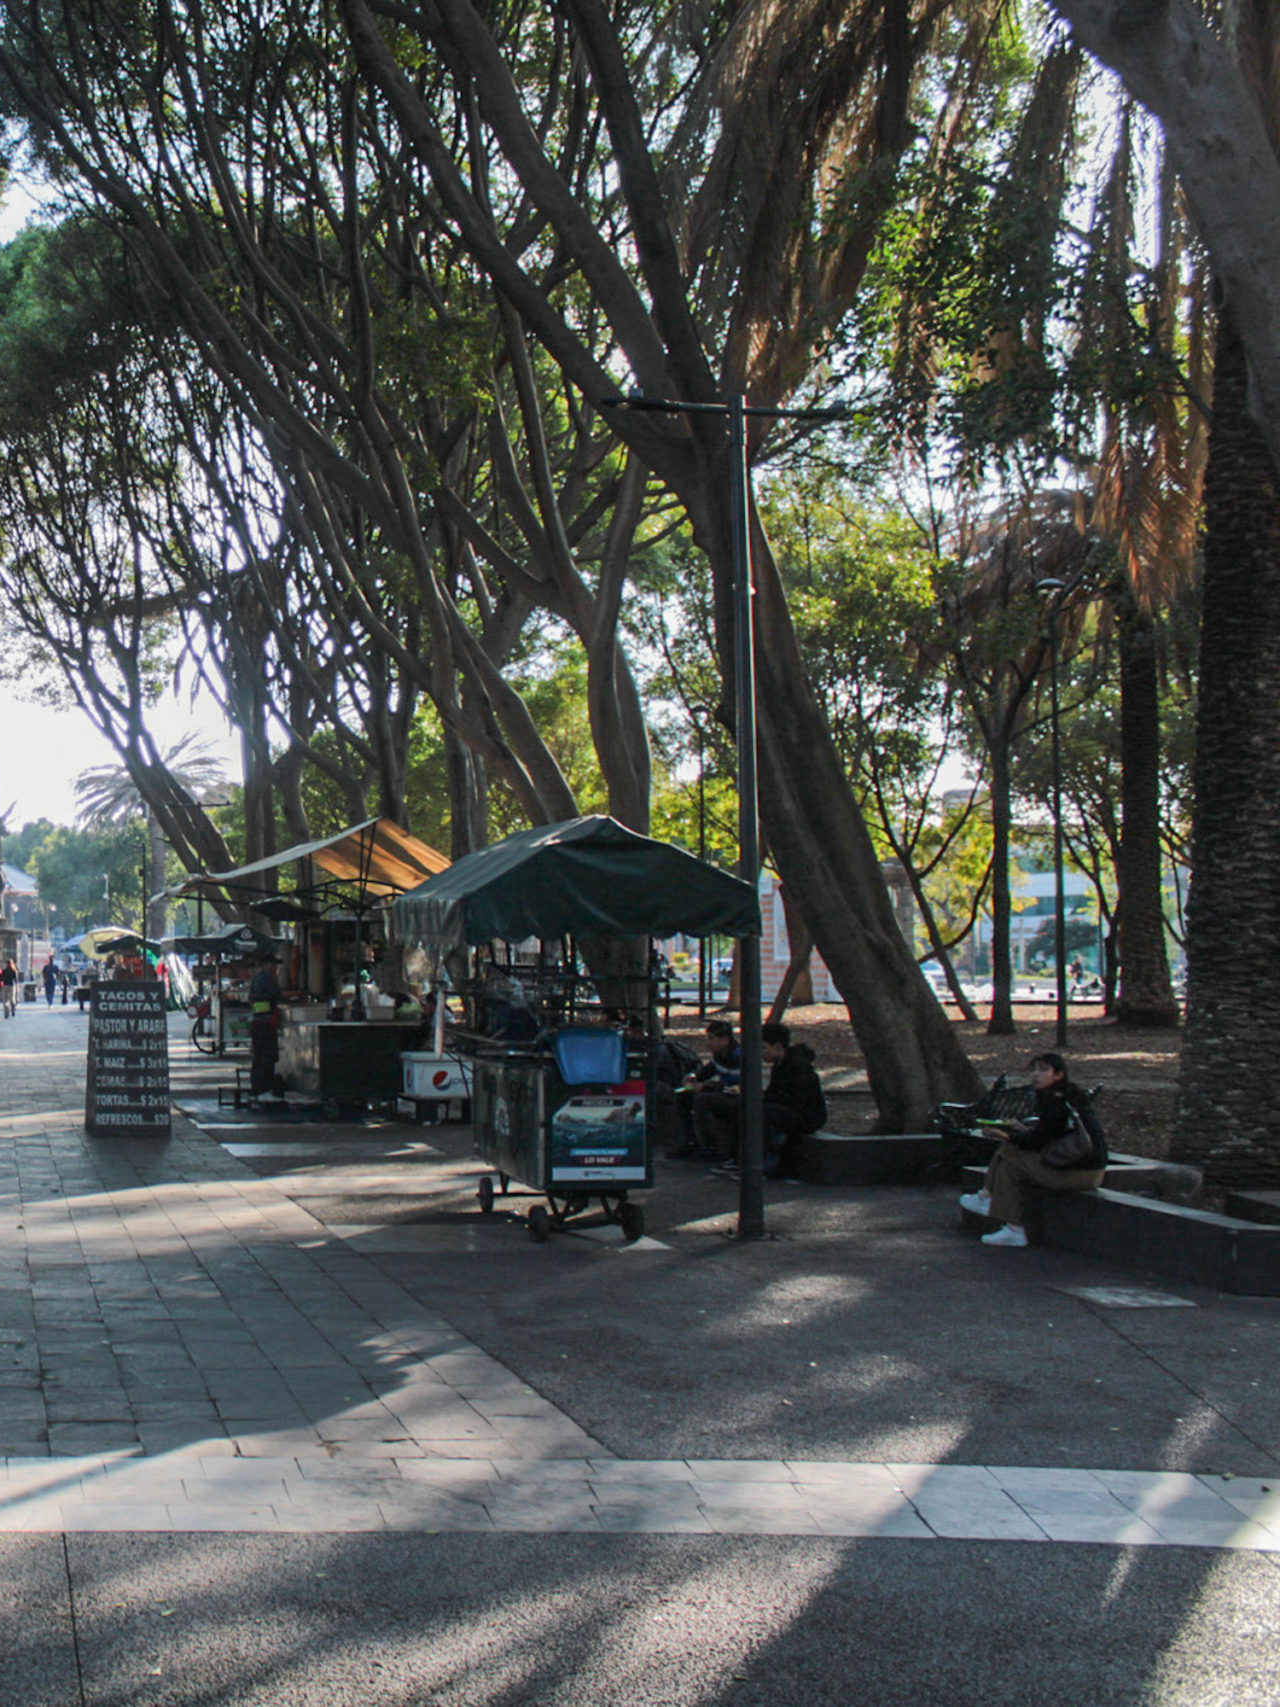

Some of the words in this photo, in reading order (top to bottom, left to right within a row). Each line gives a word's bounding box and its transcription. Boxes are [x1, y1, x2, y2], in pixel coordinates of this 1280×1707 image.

[98, 991, 145, 1001] TACOS
[149, 991, 159, 1001] Y
[98, 1002, 161, 1012] CEMITAS
[94, 1018, 128, 1034] PASTOR
[129, 1019, 136, 1033] Y
[138, 1019, 166, 1034] ARABE
